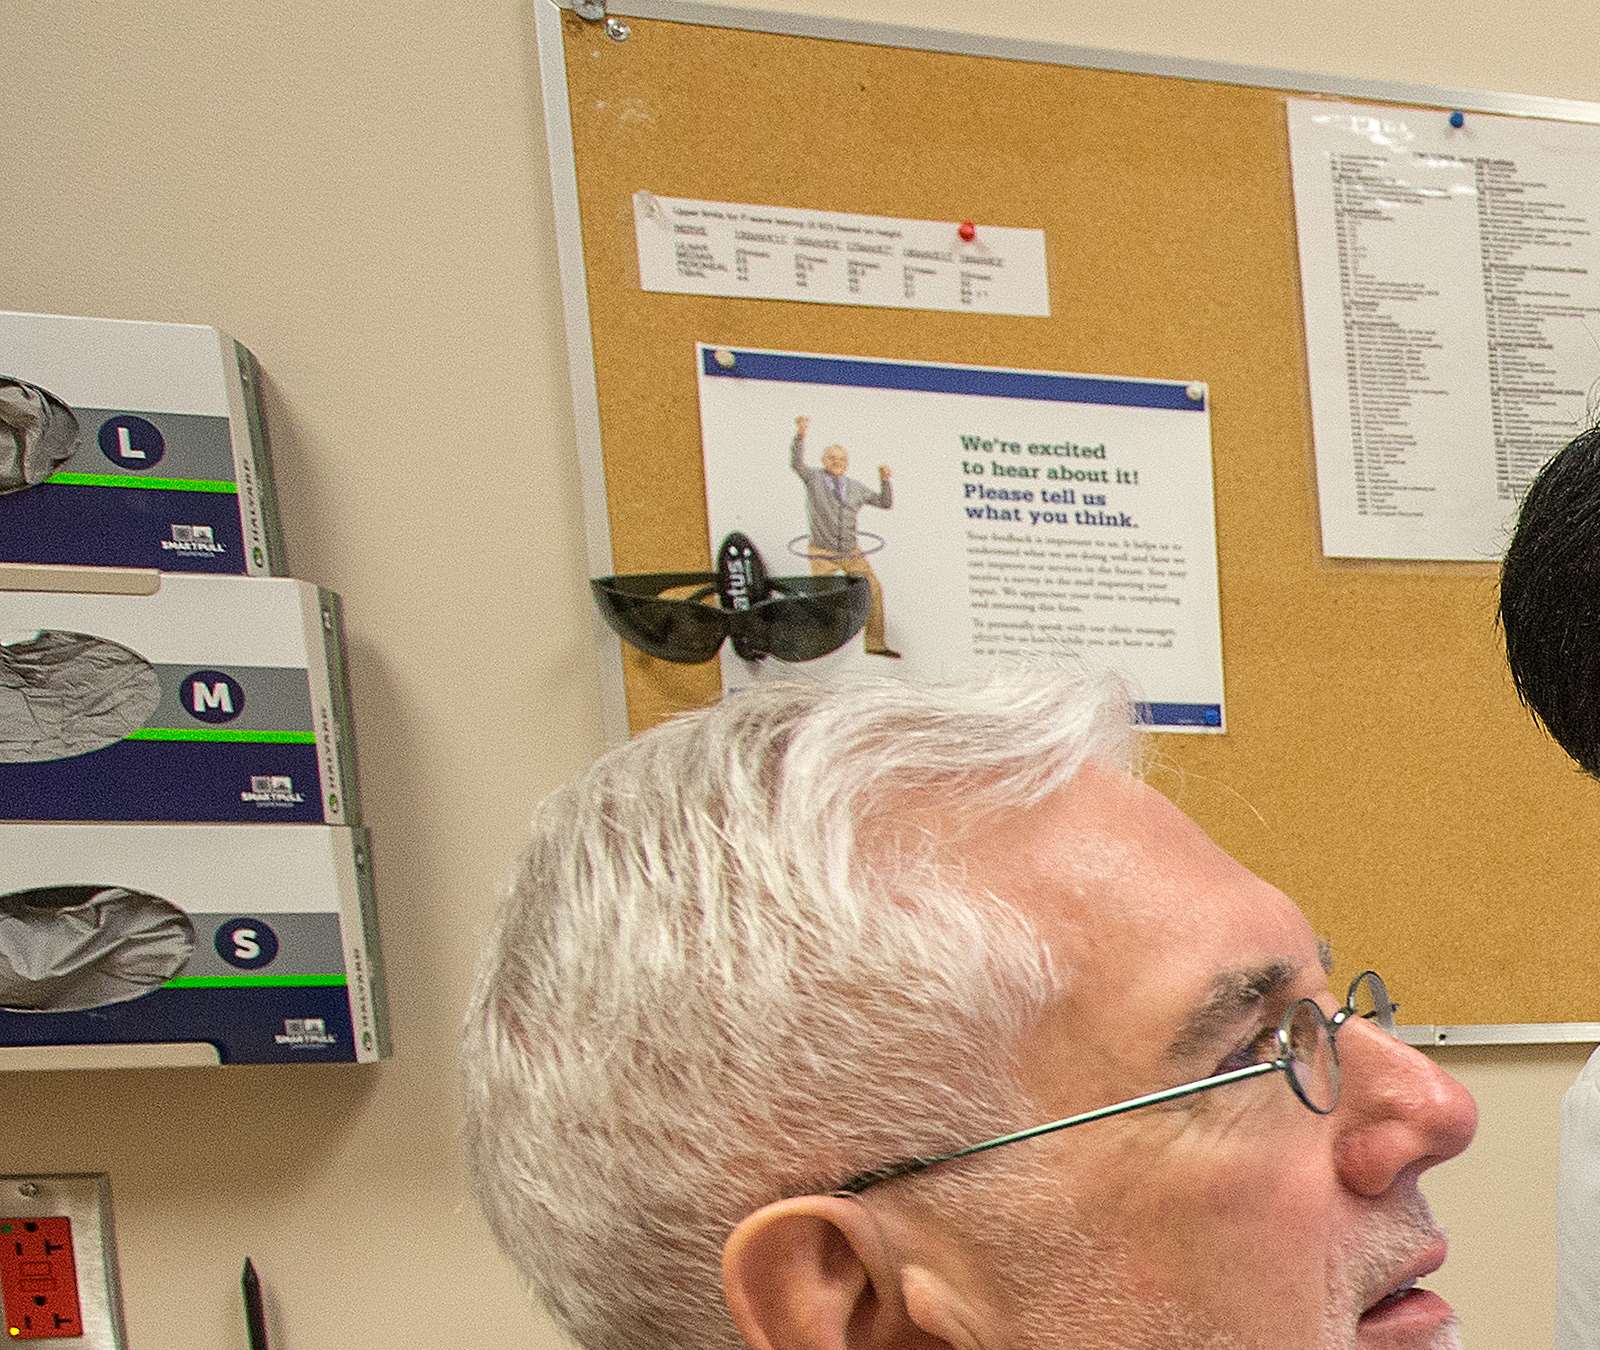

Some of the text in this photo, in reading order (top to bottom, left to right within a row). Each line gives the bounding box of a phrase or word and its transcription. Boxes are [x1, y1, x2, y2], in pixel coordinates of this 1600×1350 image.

[119, 427, 147, 460] L
[960, 435, 1107, 460] We're excited
[961, 460, 1139, 485] to hear about it!
[963, 483, 1107, 506] Please tell us
[964, 505, 1139, 529] what you think.
[193, 681, 233, 714] M
[231, 929, 261, 959] S
